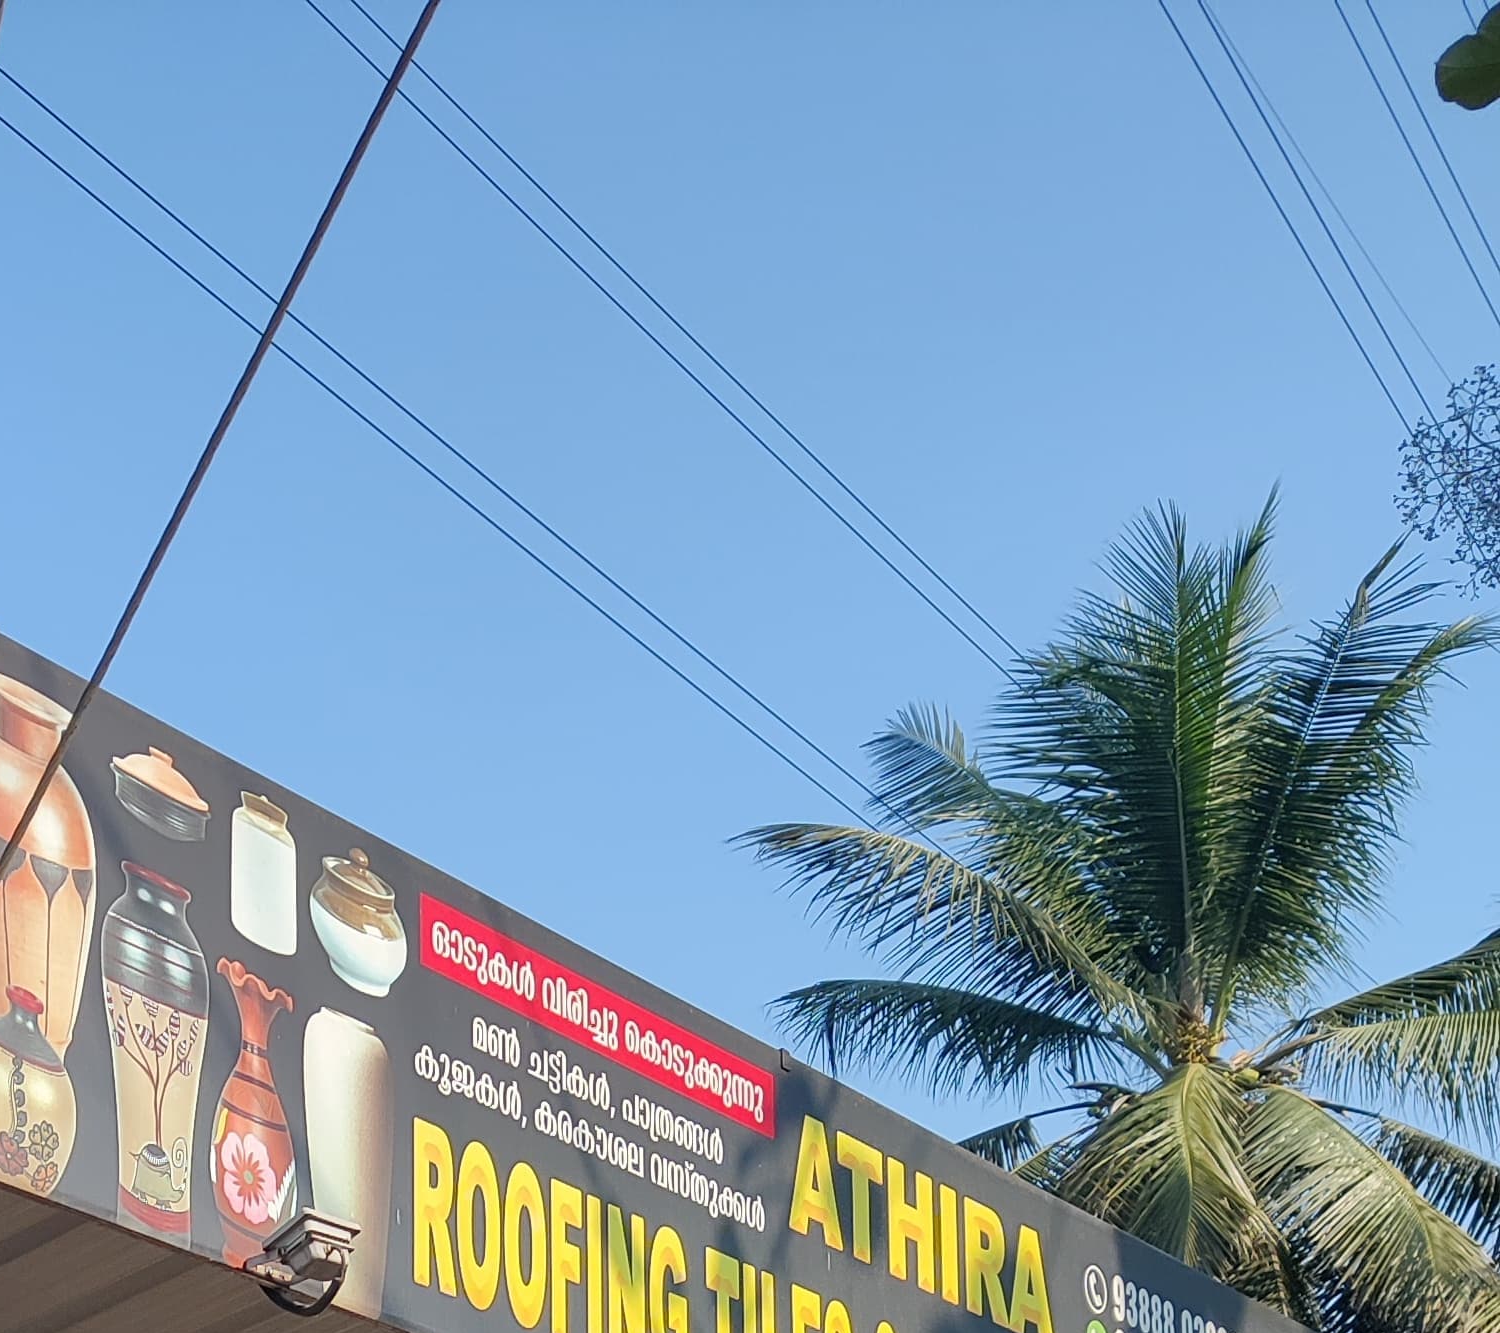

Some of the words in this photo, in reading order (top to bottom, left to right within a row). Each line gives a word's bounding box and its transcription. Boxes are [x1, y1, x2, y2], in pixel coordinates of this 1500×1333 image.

[431, 920, 536, 1002] ഓടുകൾ
[541, 976, 619, 1052] വിരിച്ചു
[624, 1020, 765, 1124] കൊടുക്കുന്നു
[622, 1094, 725, 1166] പാത്രങ്ങൾ
[650, 1152, 766, 1233] വസ്തുക്കൾ
